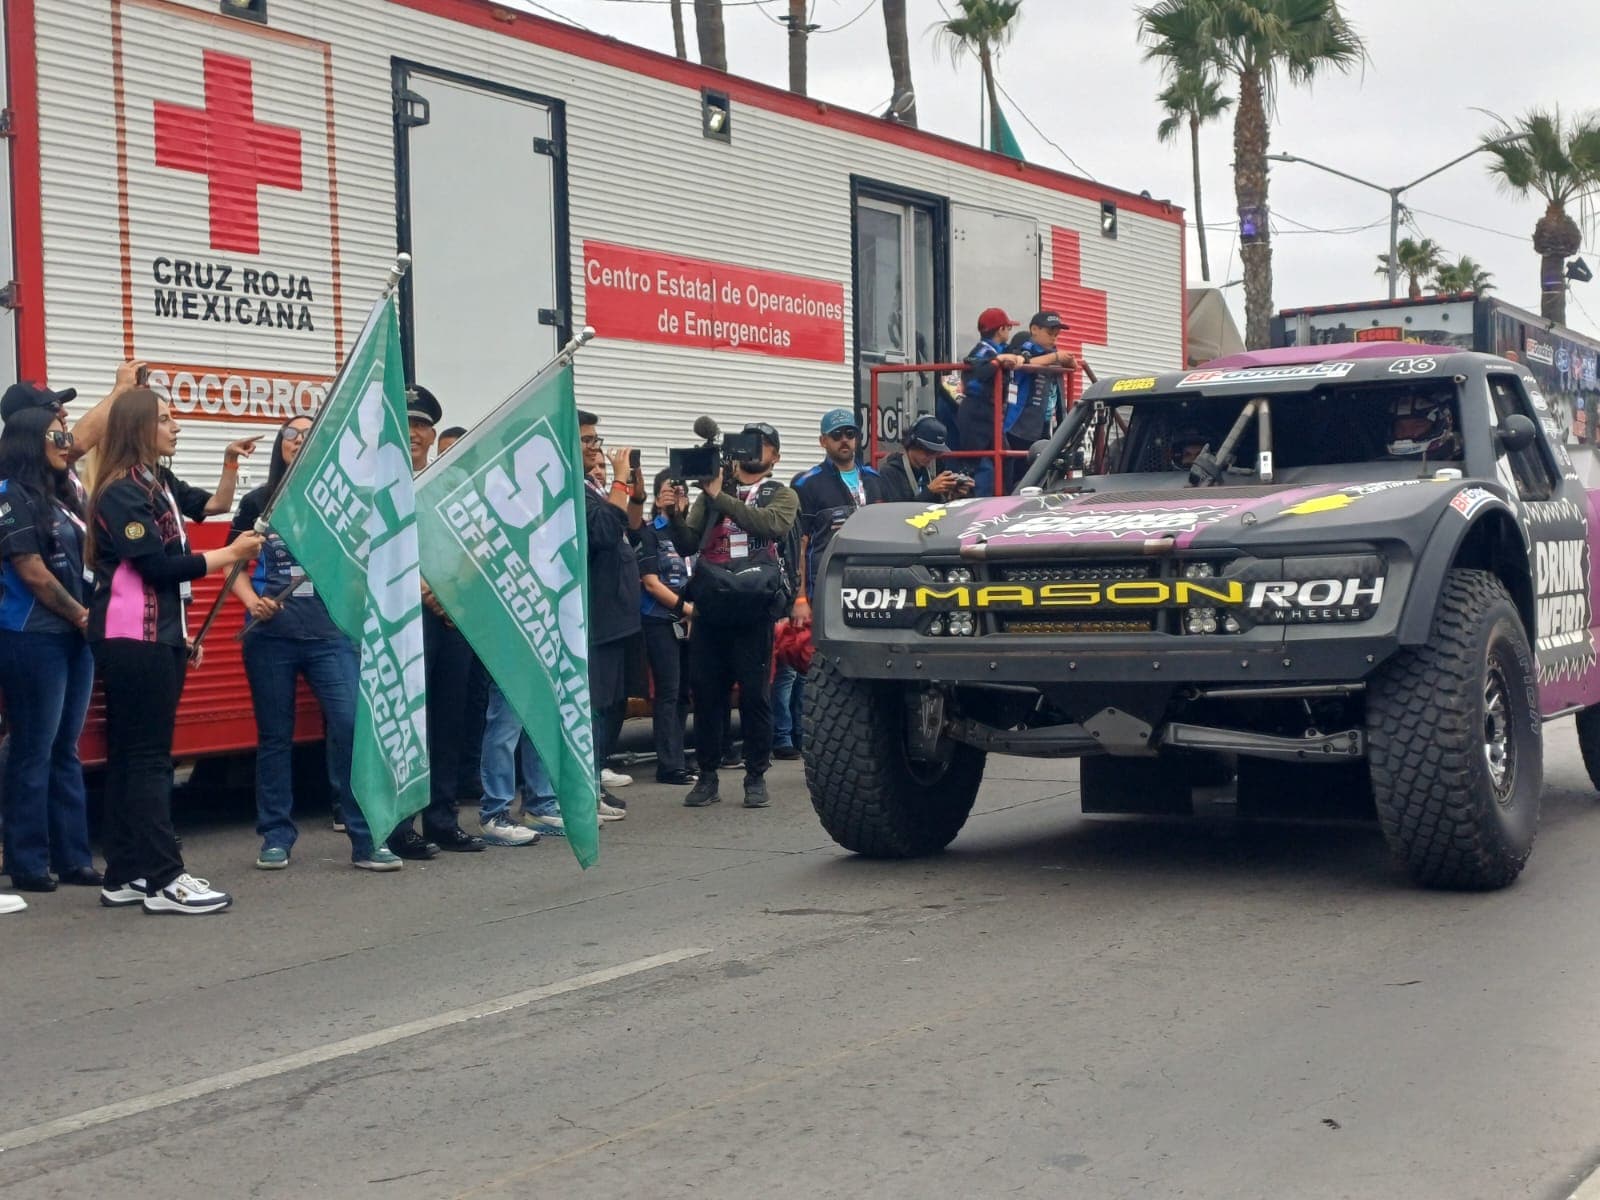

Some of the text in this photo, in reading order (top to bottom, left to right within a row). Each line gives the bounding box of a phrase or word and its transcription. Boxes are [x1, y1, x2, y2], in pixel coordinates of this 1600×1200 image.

[153, 256, 314, 302] CRUZ ROJA
[586, 258, 843, 321] Centro Estatal de Operaciones
[154, 289, 315, 333] MEXICANA
[657, 308, 792, 347] de Emergencias
[1184, 363, 1353, 384] BFGoodrich
[1388, 356, 1438, 375] 46
[148, 369, 335, 419] SOCORRO
[446, 501, 557, 669] OFF-ROAD
[1535, 539, 1585, 595] DRINK
[840, 576, 1385, 610] ROH MASON ROH
[1274, 608, 1360, 619] WHEELS
[847, 611, 892, 620] WHEELS
[1537, 592, 1586, 651] WEIRD
